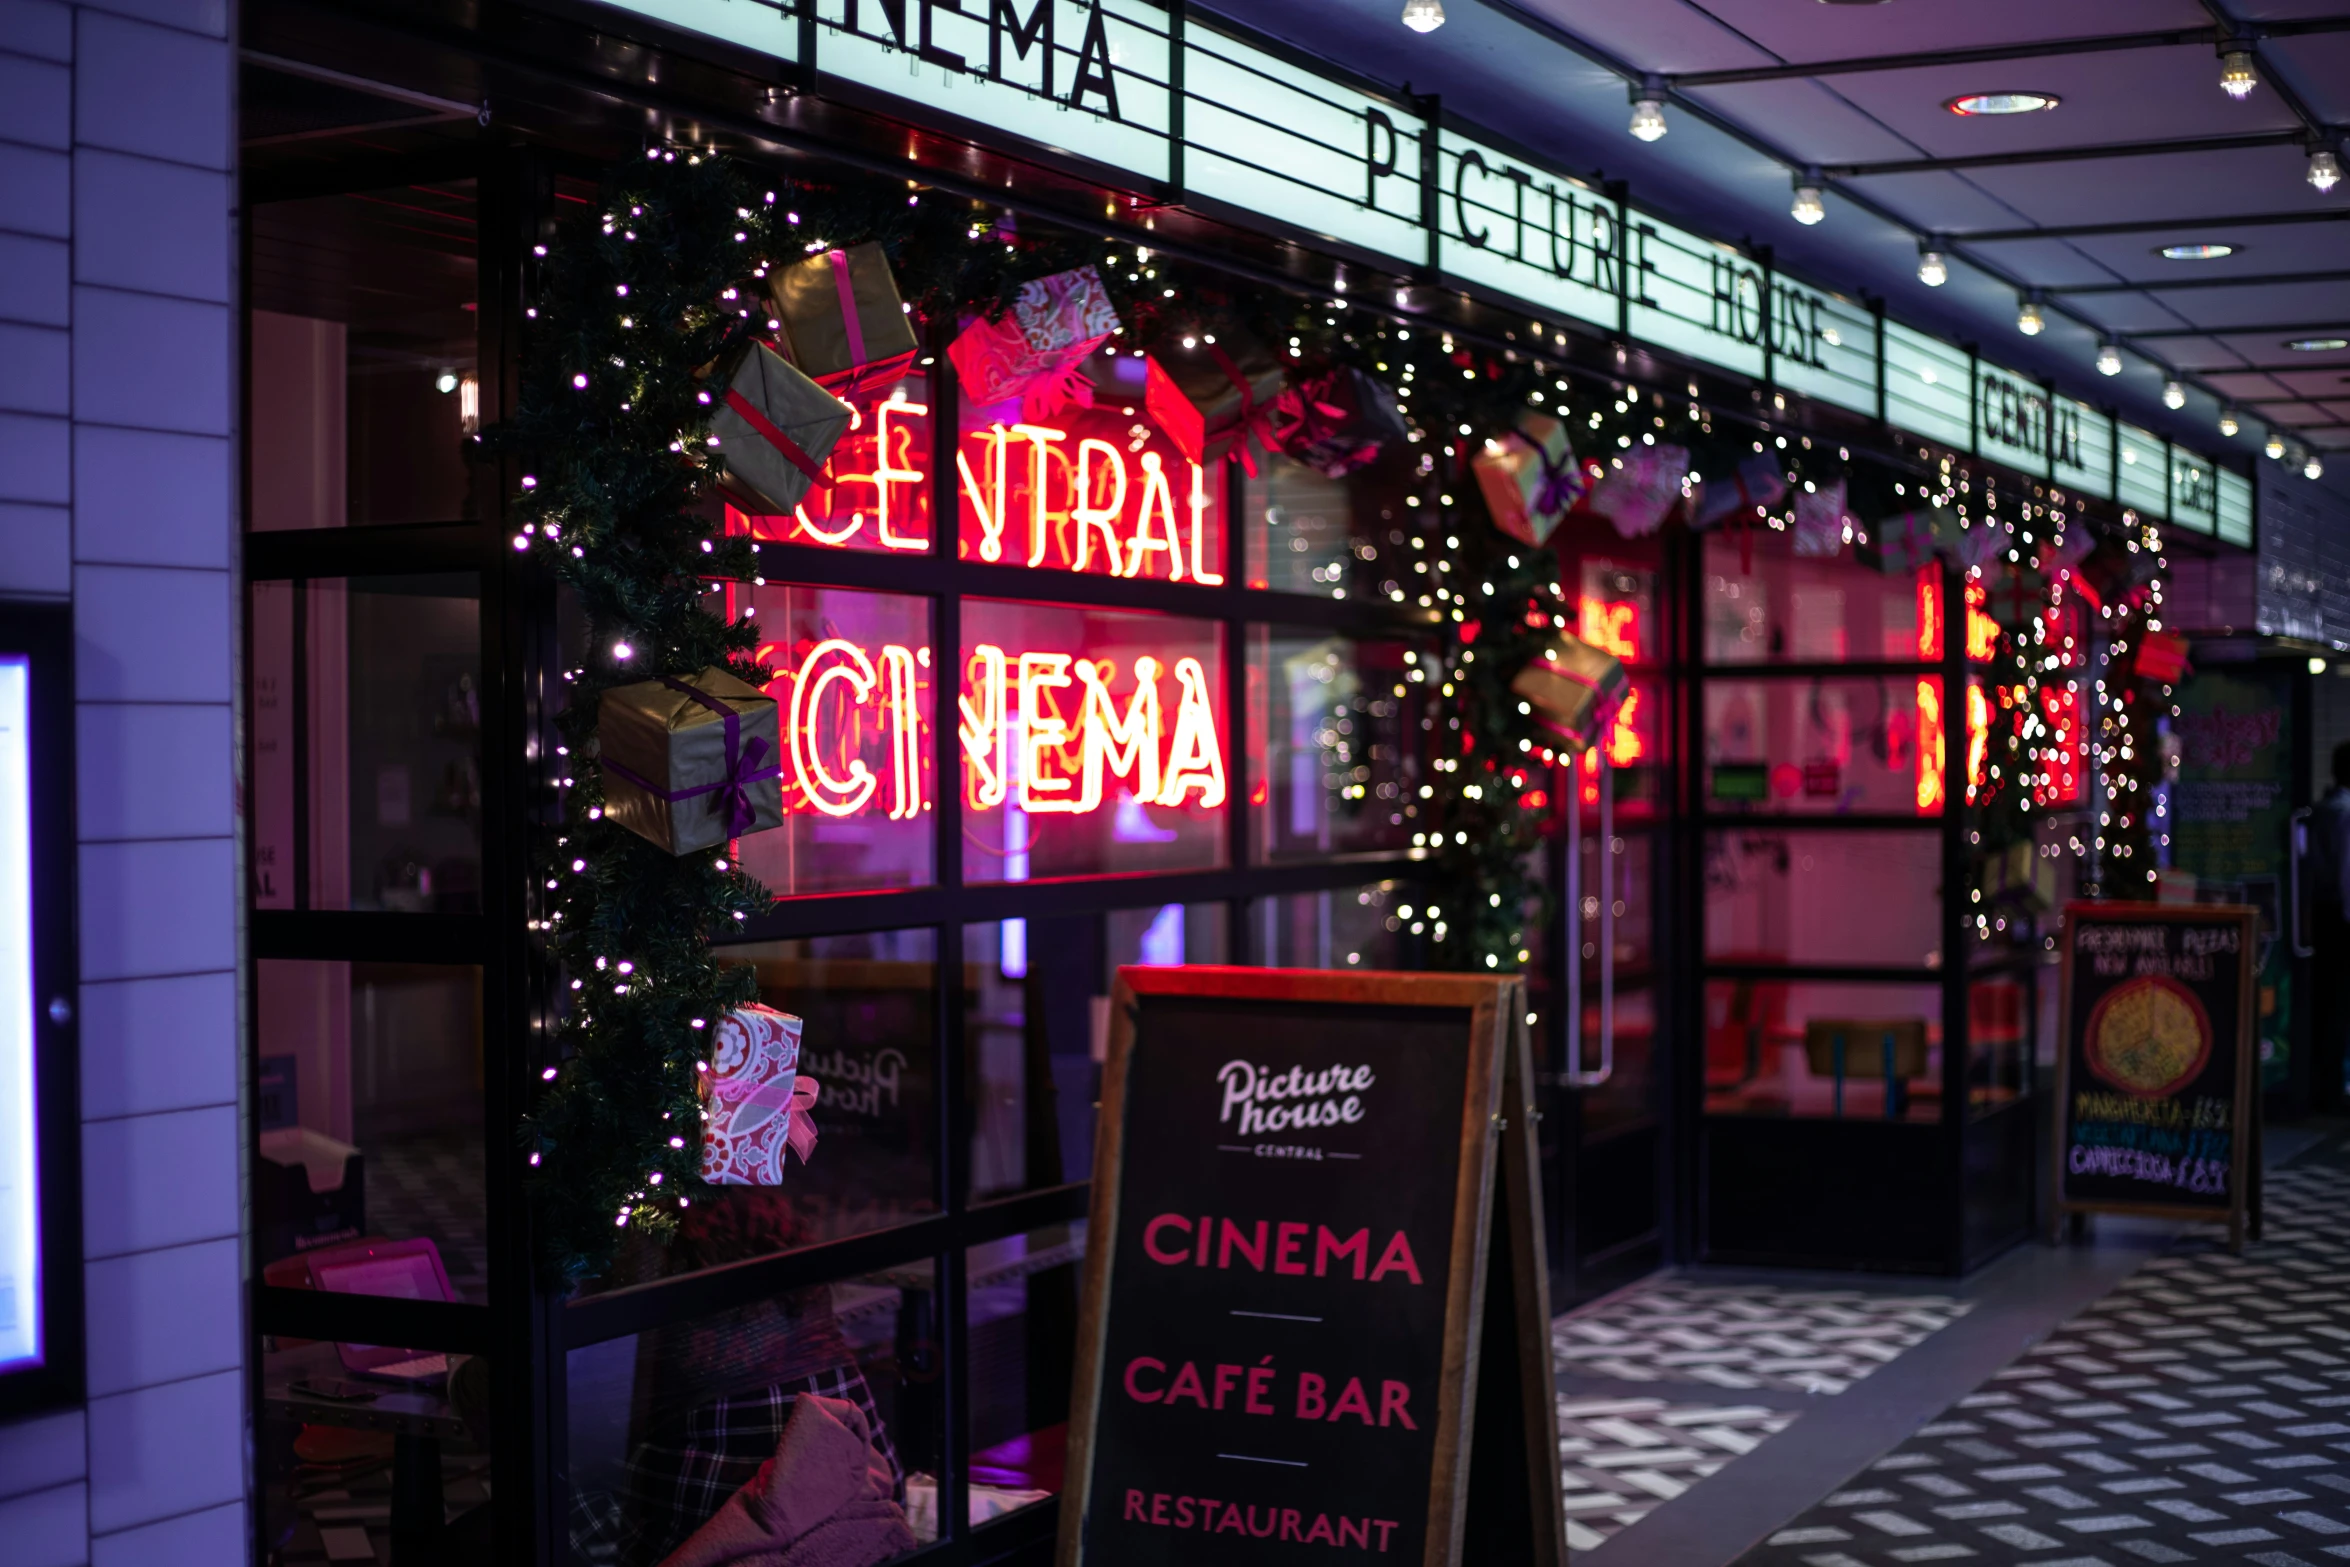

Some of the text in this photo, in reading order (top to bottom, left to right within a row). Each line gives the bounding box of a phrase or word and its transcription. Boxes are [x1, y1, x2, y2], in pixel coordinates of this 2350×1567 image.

[1367, 106, 1658, 309] PICTURE
[1713, 253, 1826, 370] HOUSE
[1984, 374, 2085, 470] CENTAL
[790, 638, 1226, 820] CINEMA
[1217, 1059, 1376, 1123] Picture
[1238, 1096, 1365, 1136] house
[1254, 1143, 1324, 1161] CENTRAL
[1143, 1213, 1423, 1285] CINEMA
[1123, 1355, 1419, 1430] CAFÉ BAR
[1123, 1489, 1399, 1552] RESTAURANT
